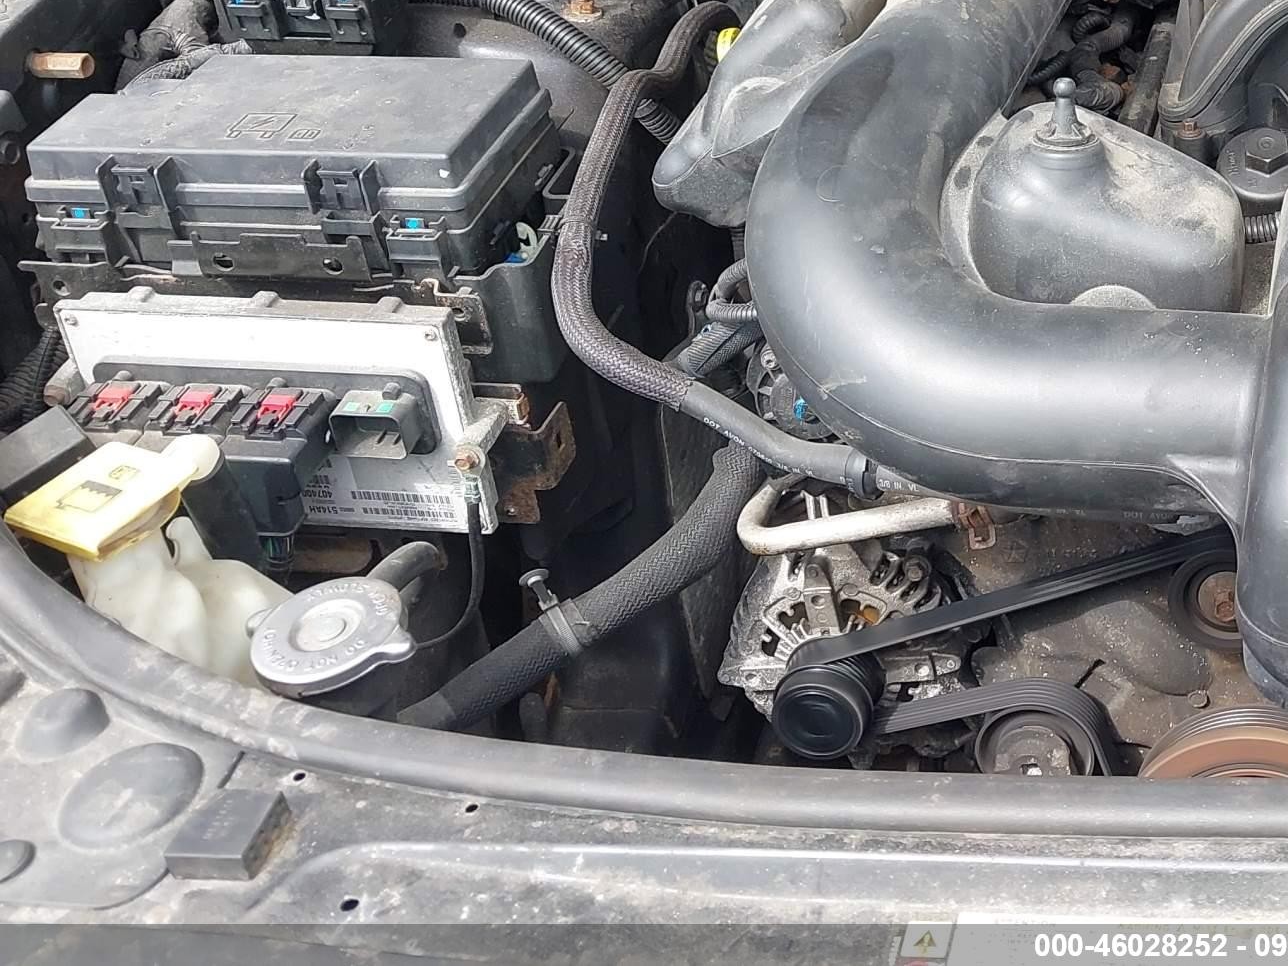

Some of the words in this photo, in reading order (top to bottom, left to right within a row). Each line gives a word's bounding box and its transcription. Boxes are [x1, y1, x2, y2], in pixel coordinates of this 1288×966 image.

[723, 430, 745, 446] AVON
[309, 505, 338, 516] 514AH
[304, 655, 338, 672] NOT
